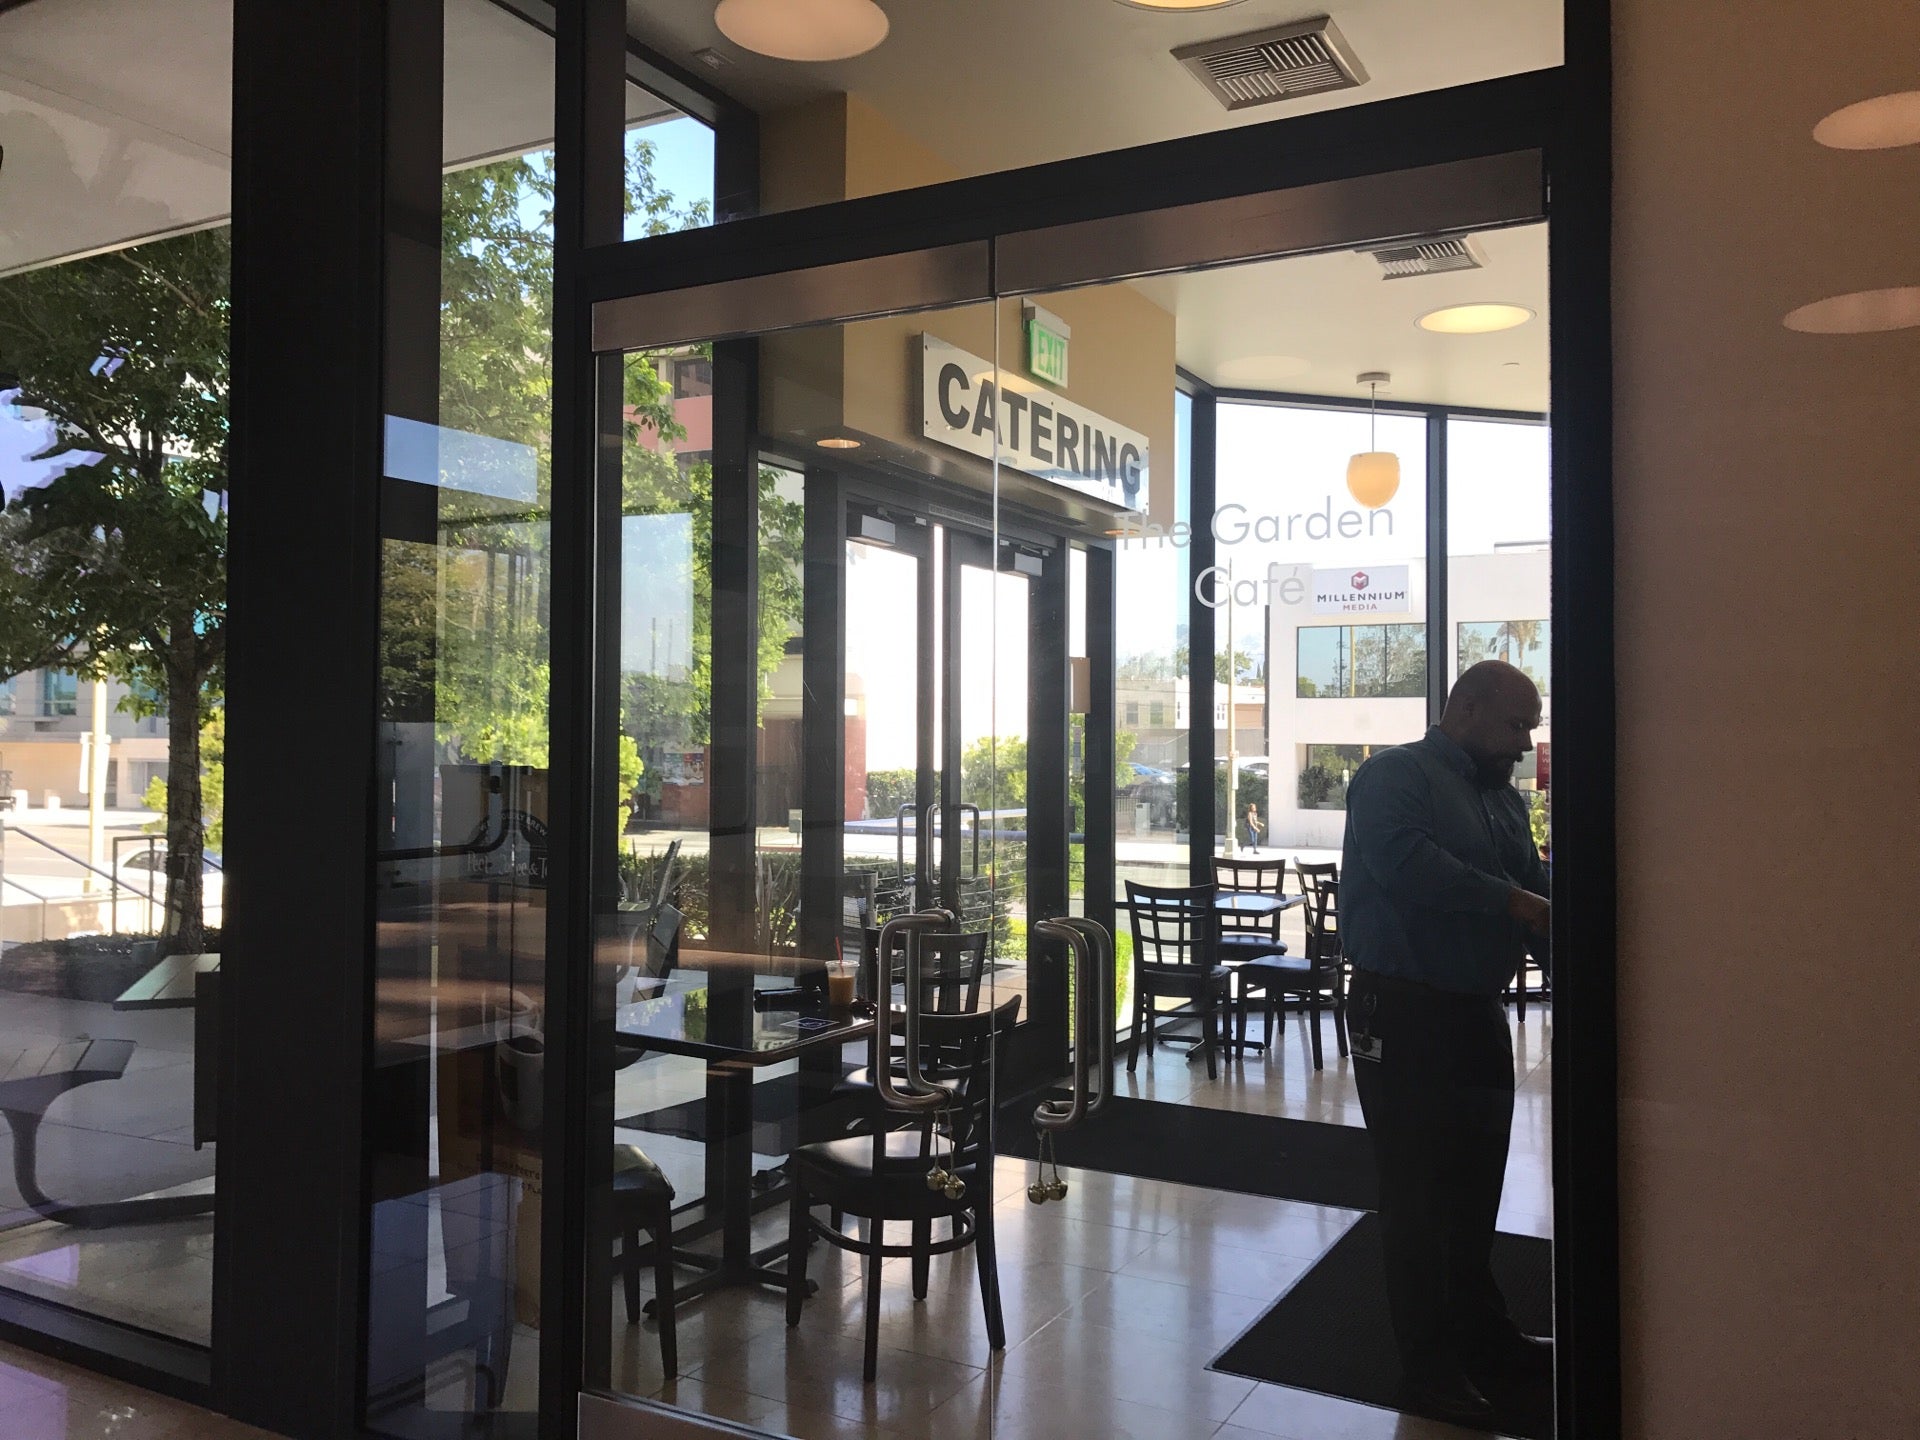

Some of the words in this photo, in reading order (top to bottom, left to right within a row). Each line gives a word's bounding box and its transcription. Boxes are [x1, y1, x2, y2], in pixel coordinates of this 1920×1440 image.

[1038, 337, 1066, 381] EXIT
[939, 362, 1141, 494] CATERING
[1113, 508, 1193, 550] The
[1211, 495, 1394, 546] Garden
[1195, 561, 1305, 609] Café
[1317, 591, 1406, 603] MILLENNIUM
[1343, 603, 1378, 611] MEDIA
